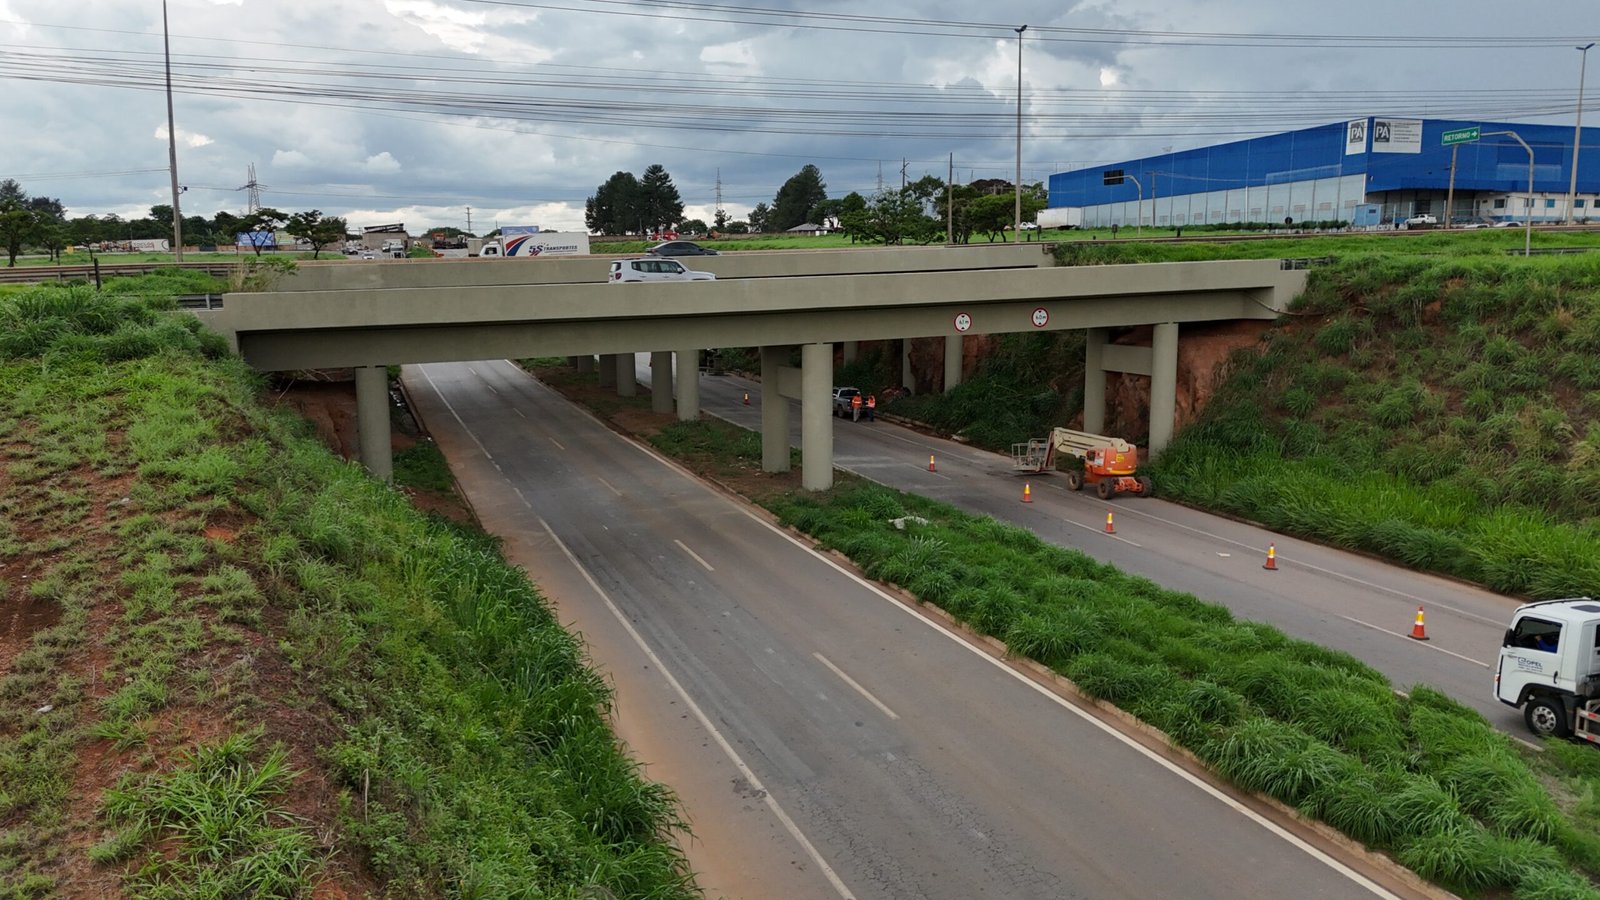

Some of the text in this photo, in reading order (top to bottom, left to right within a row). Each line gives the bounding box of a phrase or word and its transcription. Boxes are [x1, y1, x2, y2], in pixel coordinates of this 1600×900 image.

[1351, 126, 1362, 139] PA
[1375, 126, 1389, 138] PA
[1444, 131, 1471, 142] RETORNO
